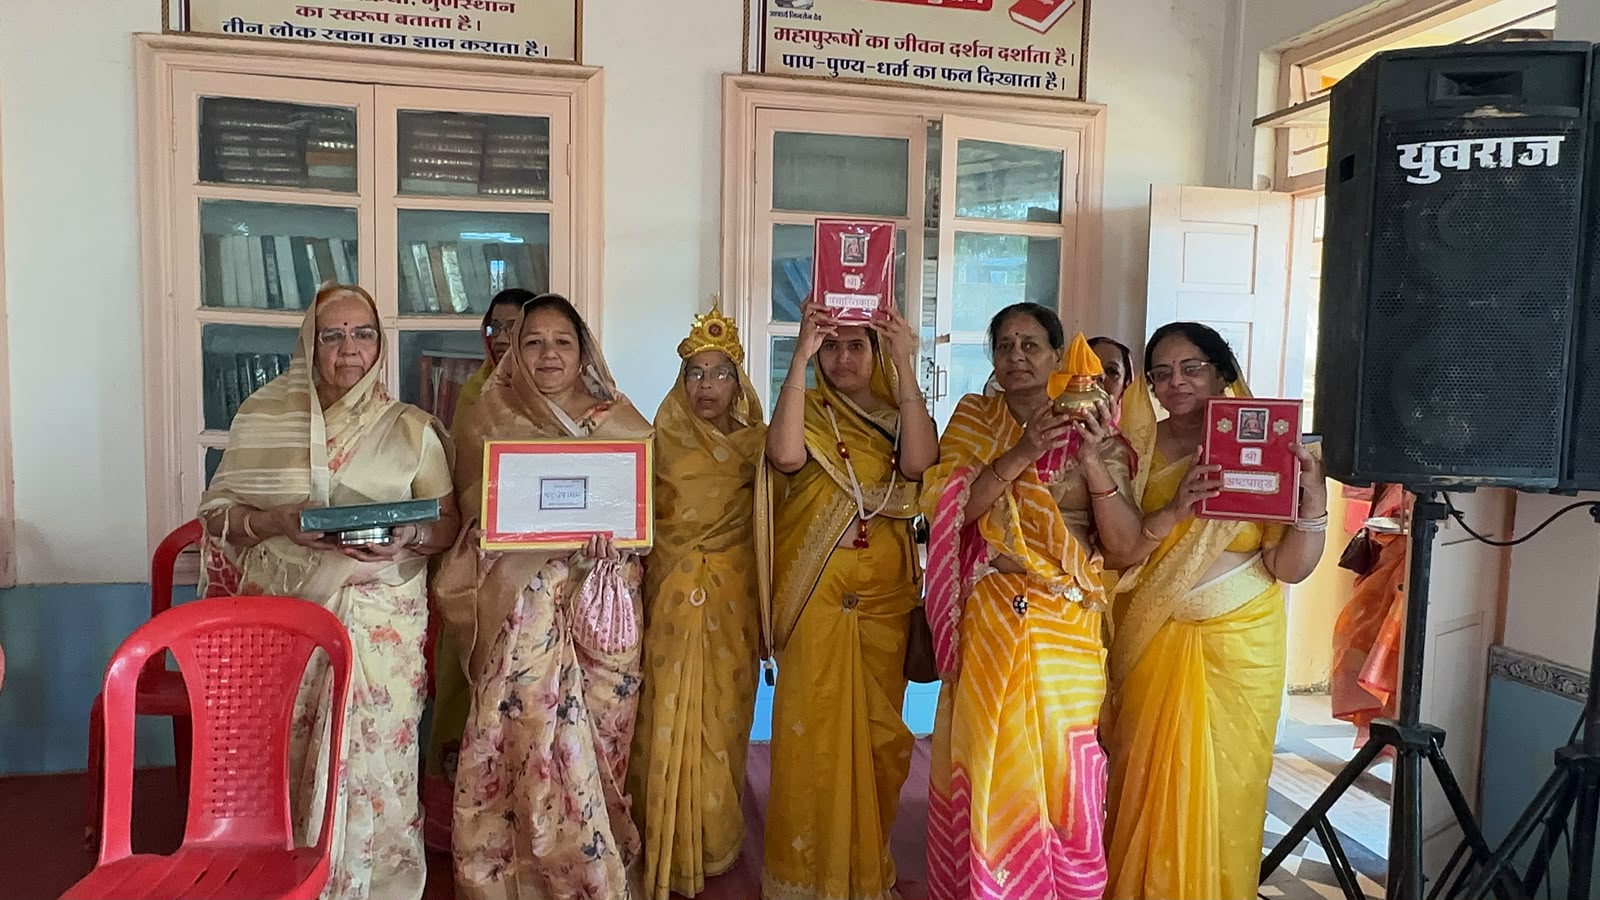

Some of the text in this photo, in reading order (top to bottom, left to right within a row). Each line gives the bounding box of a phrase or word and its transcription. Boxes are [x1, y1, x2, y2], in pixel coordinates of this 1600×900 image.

[296, 5, 323, 18] का
[330, 8, 390, 24] स्वरूप
[395, 13, 451, 29] बताता
[222, 17, 264, 34] तीन
[269, 21, 316, 38] लोक
[322, 28, 374, 43] रचना
[379, 33, 407, 46] का
[412, 36, 455, 49] ज्ञान
[460, 39, 519, 54] कराता
[774, 26, 863, 50] महापुरूषों
[865, 34, 889, 50] का
[894, 33, 945, 55] जीवन
[949, 40, 993, 59] दर्शन
[998, 44, 1050, 64] दर्शाता
[913, 65, 936, 80] का
[941, 67, 972, 83] फल
[977, 65, 1041, 88] दिखाता
[1396, 136, 1565, 184] युवराज
[1245, 450, 1257, 462] श्री
